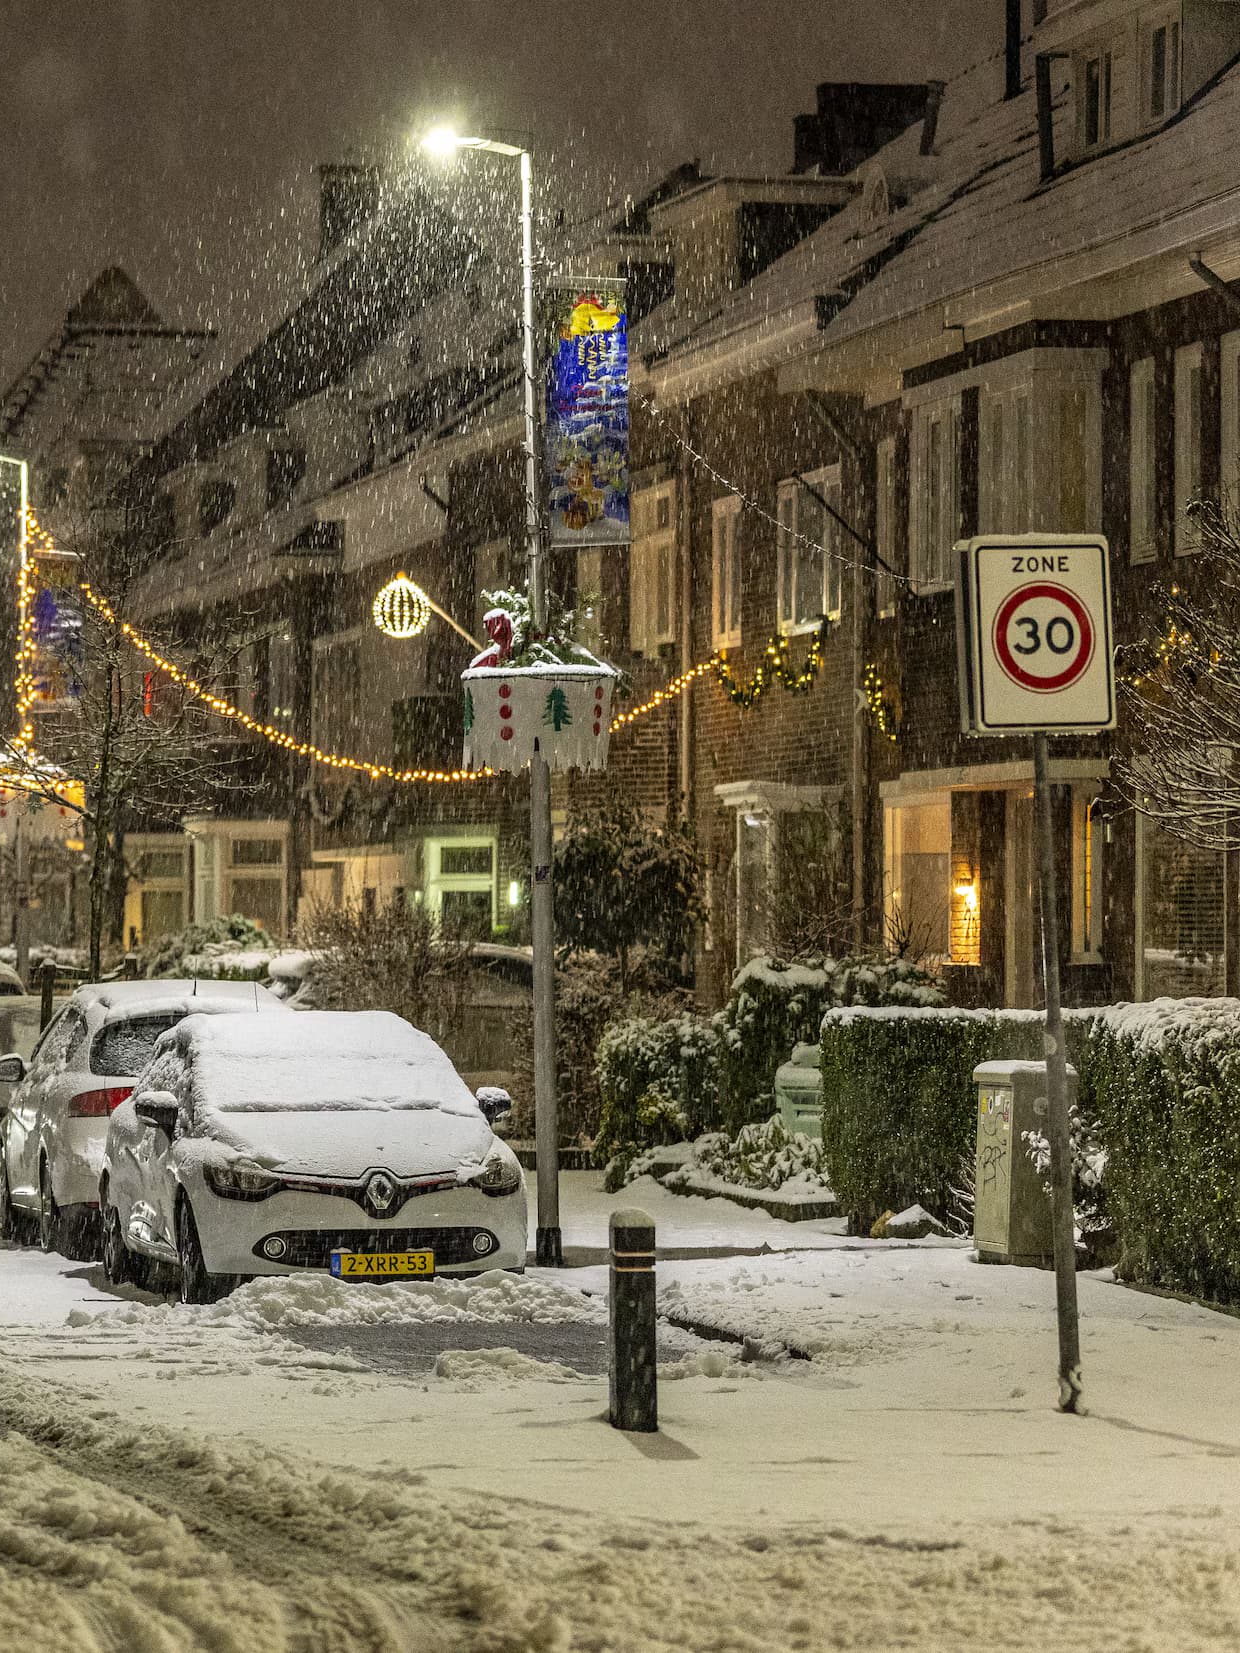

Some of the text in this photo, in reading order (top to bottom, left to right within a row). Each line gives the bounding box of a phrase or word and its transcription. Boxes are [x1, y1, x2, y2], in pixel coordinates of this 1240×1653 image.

[1011, 556, 1070, 573] ZONE
[1013, 616, 1074, 655] 30
[347, 1255, 427, 1272] 2-XRR-53
